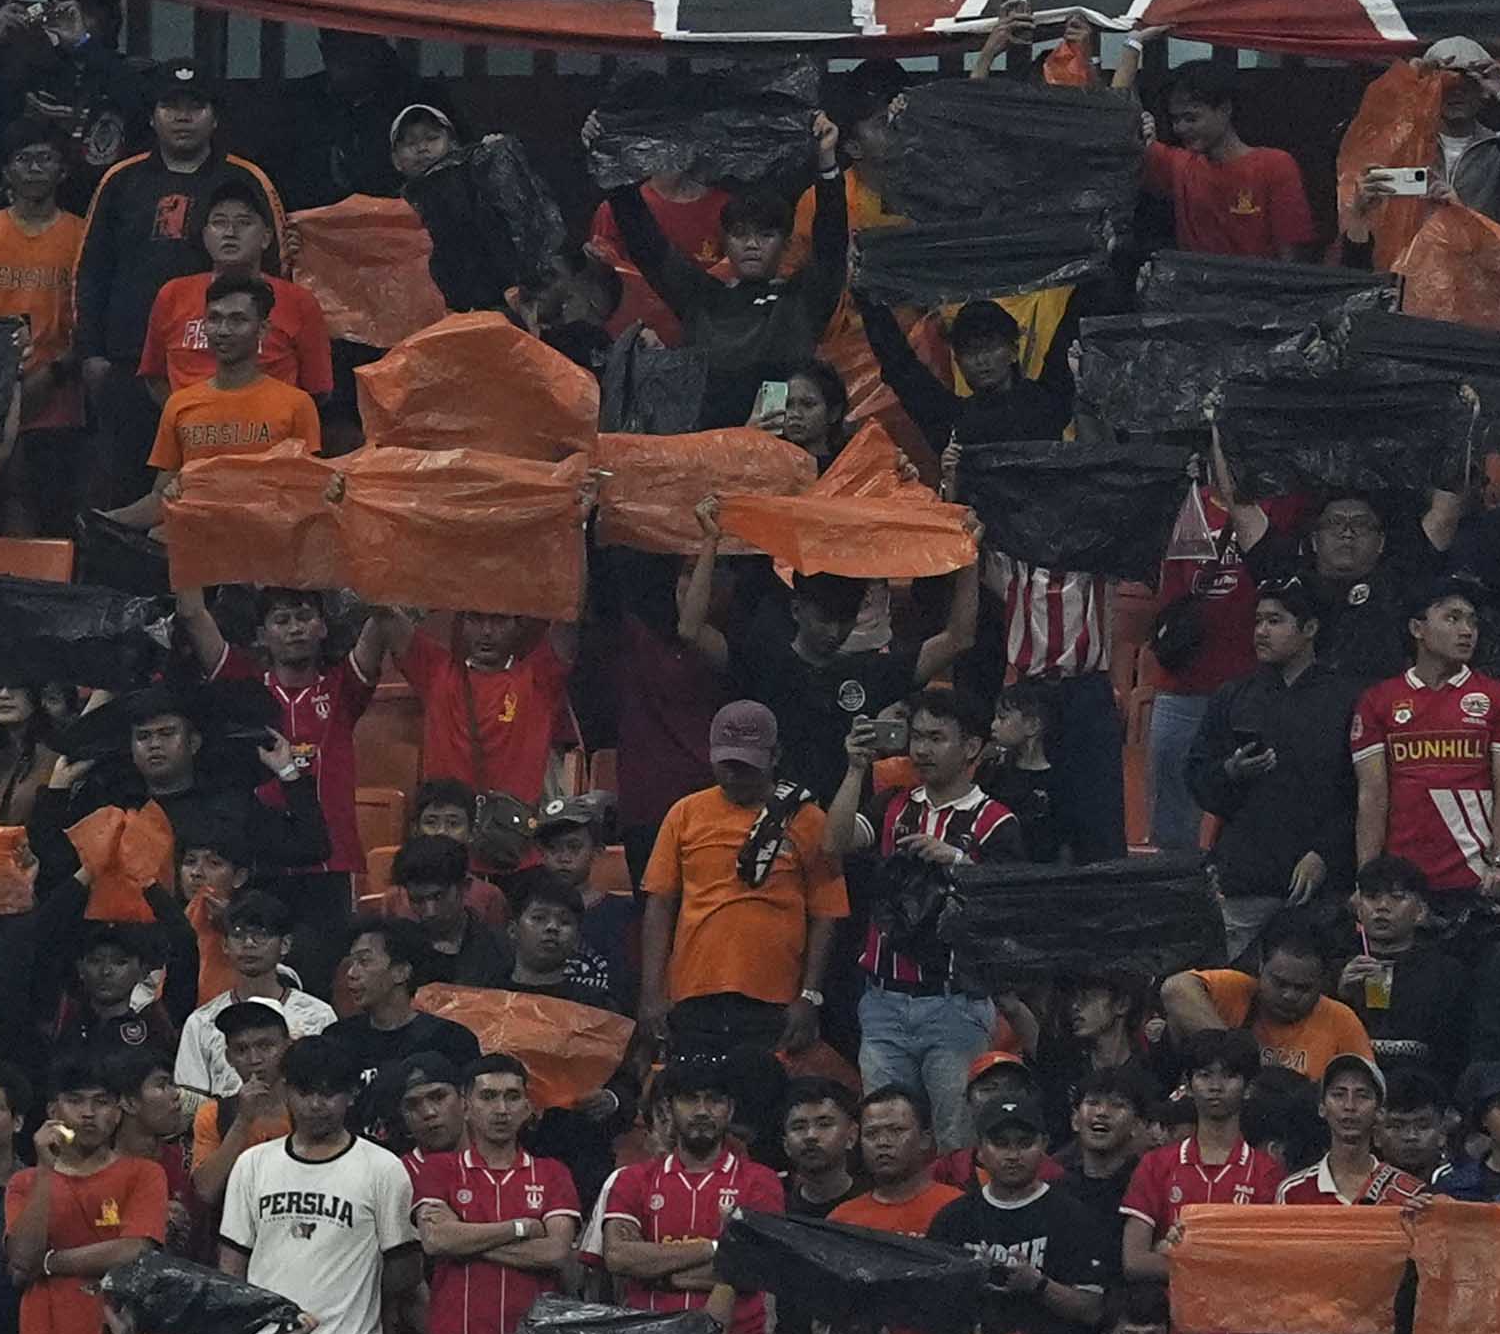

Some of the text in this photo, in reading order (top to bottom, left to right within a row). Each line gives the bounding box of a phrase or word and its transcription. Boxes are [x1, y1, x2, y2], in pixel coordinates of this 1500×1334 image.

[180, 423, 272, 447] PERSIJA
[1392, 741, 1484, 764] DUNHILL
[259, 1191, 354, 1229] PERSIJA
